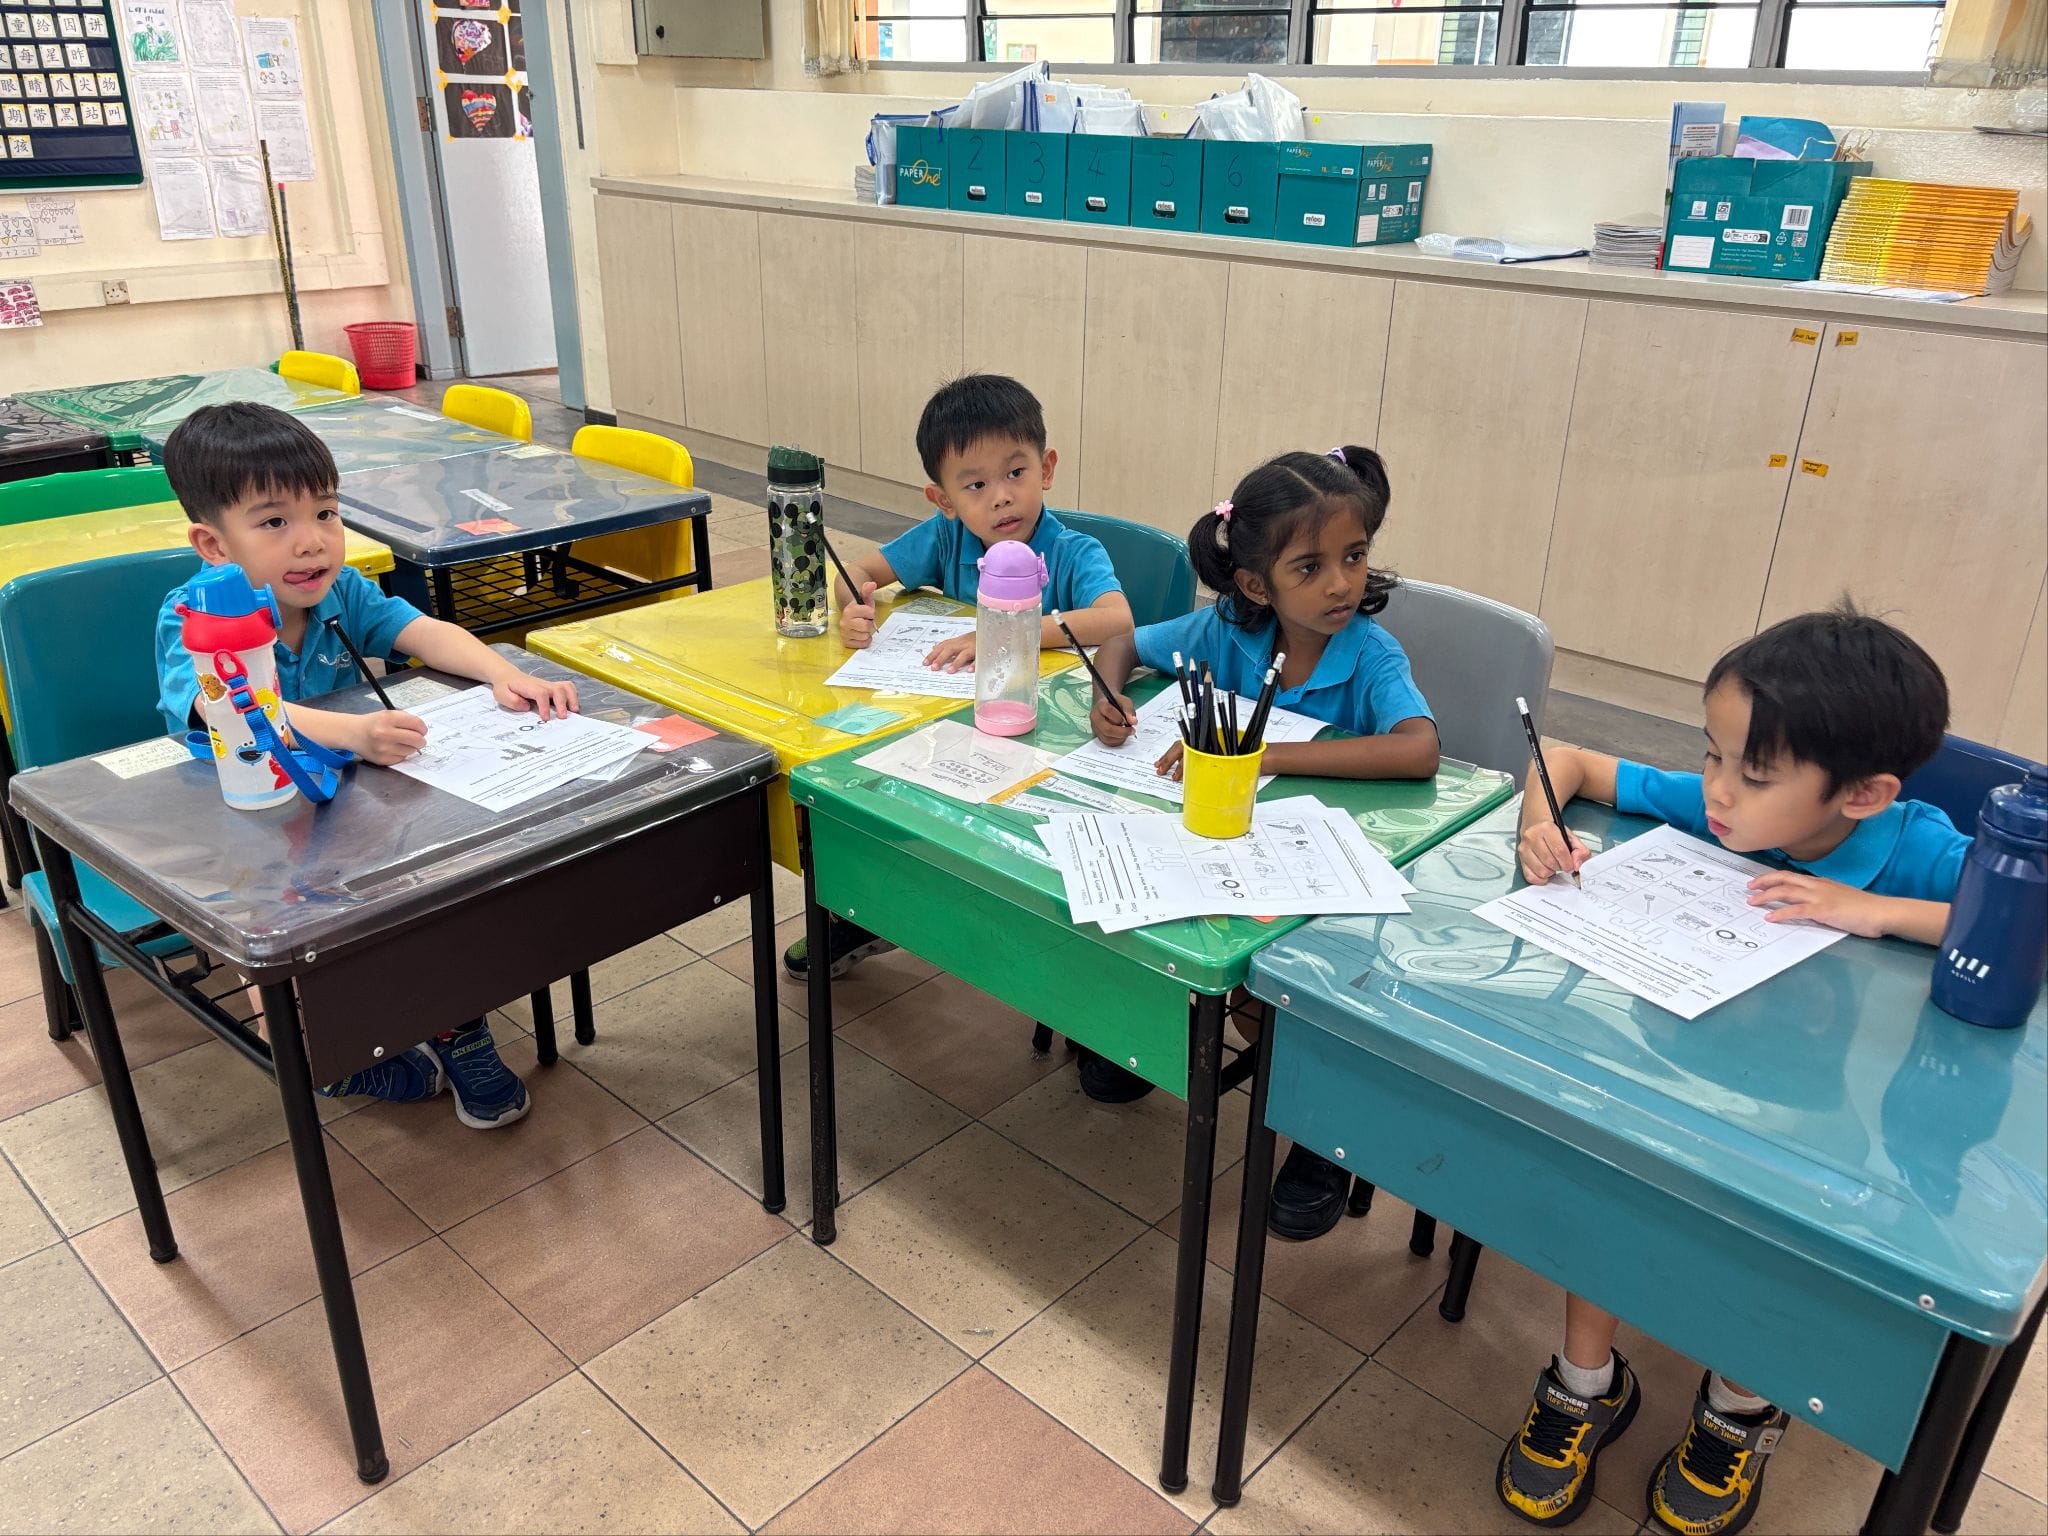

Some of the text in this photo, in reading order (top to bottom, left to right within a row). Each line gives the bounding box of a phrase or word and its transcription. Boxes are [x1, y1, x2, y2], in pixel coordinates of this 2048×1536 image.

[11, 17, 25, 33] 童
[36, 18, 51, 33] 给
[88, 17, 103, 33] 讲
[19, 47, 34, 64] 每
[46, 47, 60, 62] 星
[71, 46, 85, 63] 昨
[1, 78, 17, 93] 眼
[56, 78, 70, 93] 爪
[79, 76, 93, 92] 尖
[102, 77, 116, 92] 物
[33, 107, 47, 124] 带
[60, 107, 74, 121] 黑
[85, 106, 99, 120] 站
[108, 106, 121, 121] 叫
[13, 139, 29, 153] 孩
[967, 134, 985, 171] 2
[1285, 147, 1302, 157] PAPER
[899, 158, 943, 188] PAPER One
[1027, 140, 1046, 184] 3
[1087, 146, 1106, 184] 4
[1159, 151, 1176, 188] 5
[1227, 154, 1243, 187] 6
[1366, 158, 1384, 169] PAPER
[1545, 1391, 1586, 1417] TUFF TRUCK
[1547, 1385, 1589, 1411] SKECHERS
[1703, 1409, 1748, 1439] SKECHERS
[1703, 1415, 1744, 1445] TUFF TRUCK
